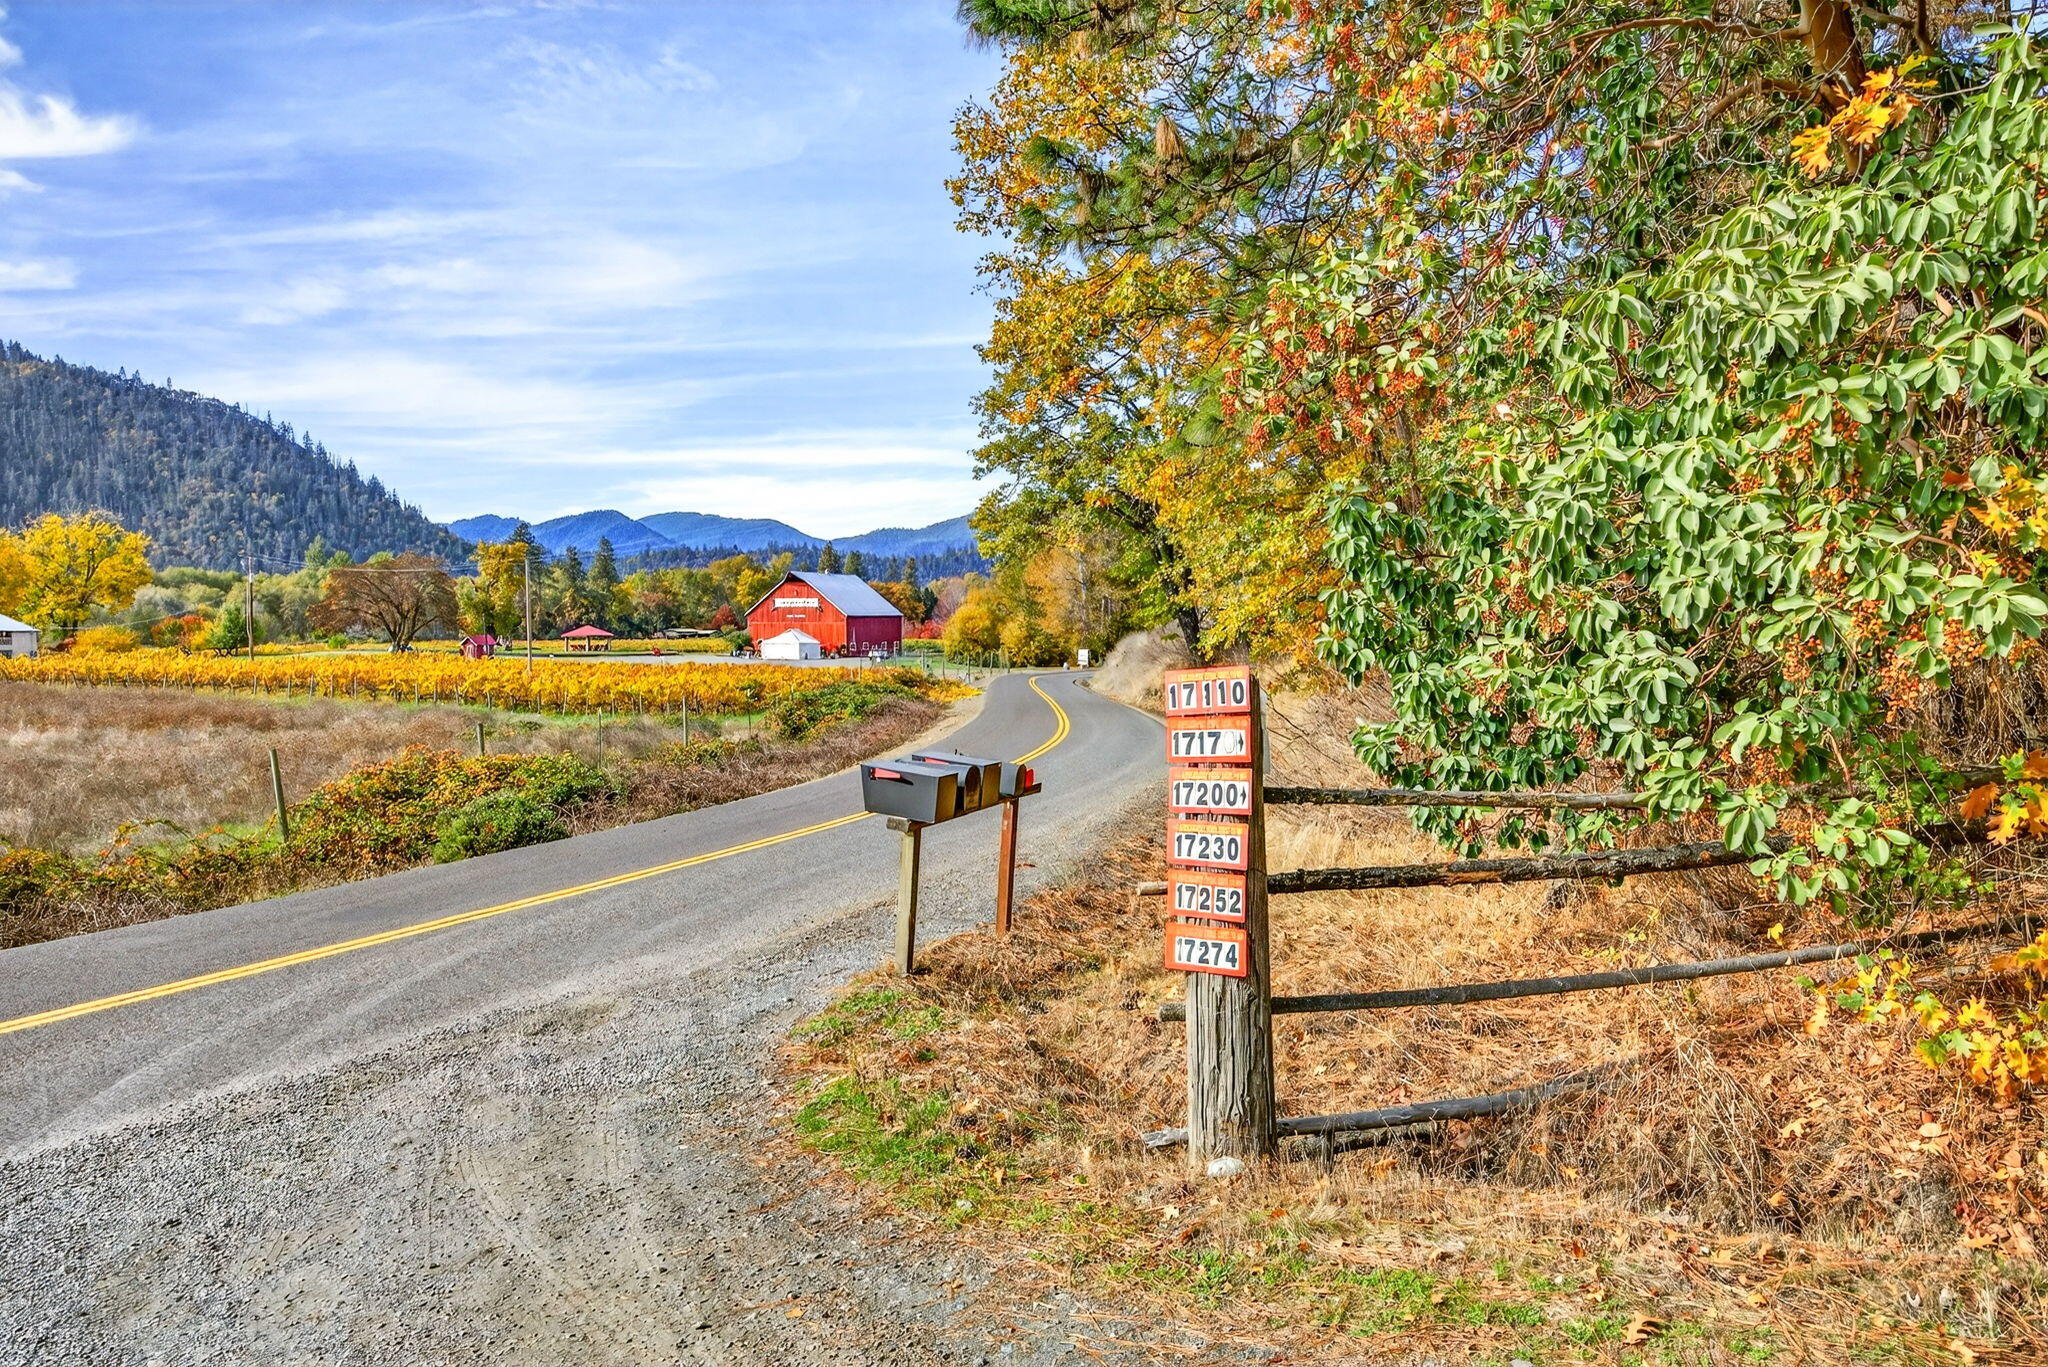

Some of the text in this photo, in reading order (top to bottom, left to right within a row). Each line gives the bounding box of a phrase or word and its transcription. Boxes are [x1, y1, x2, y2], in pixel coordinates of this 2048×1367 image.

[1169, 680, 1245, 709] 17110
[1173, 781, 1239, 807] 17200
[1176, 833, 1240, 862] 17230
[1176, 883, 1242, 915] 17252
[1176, 937, 1239, 968] 17274
